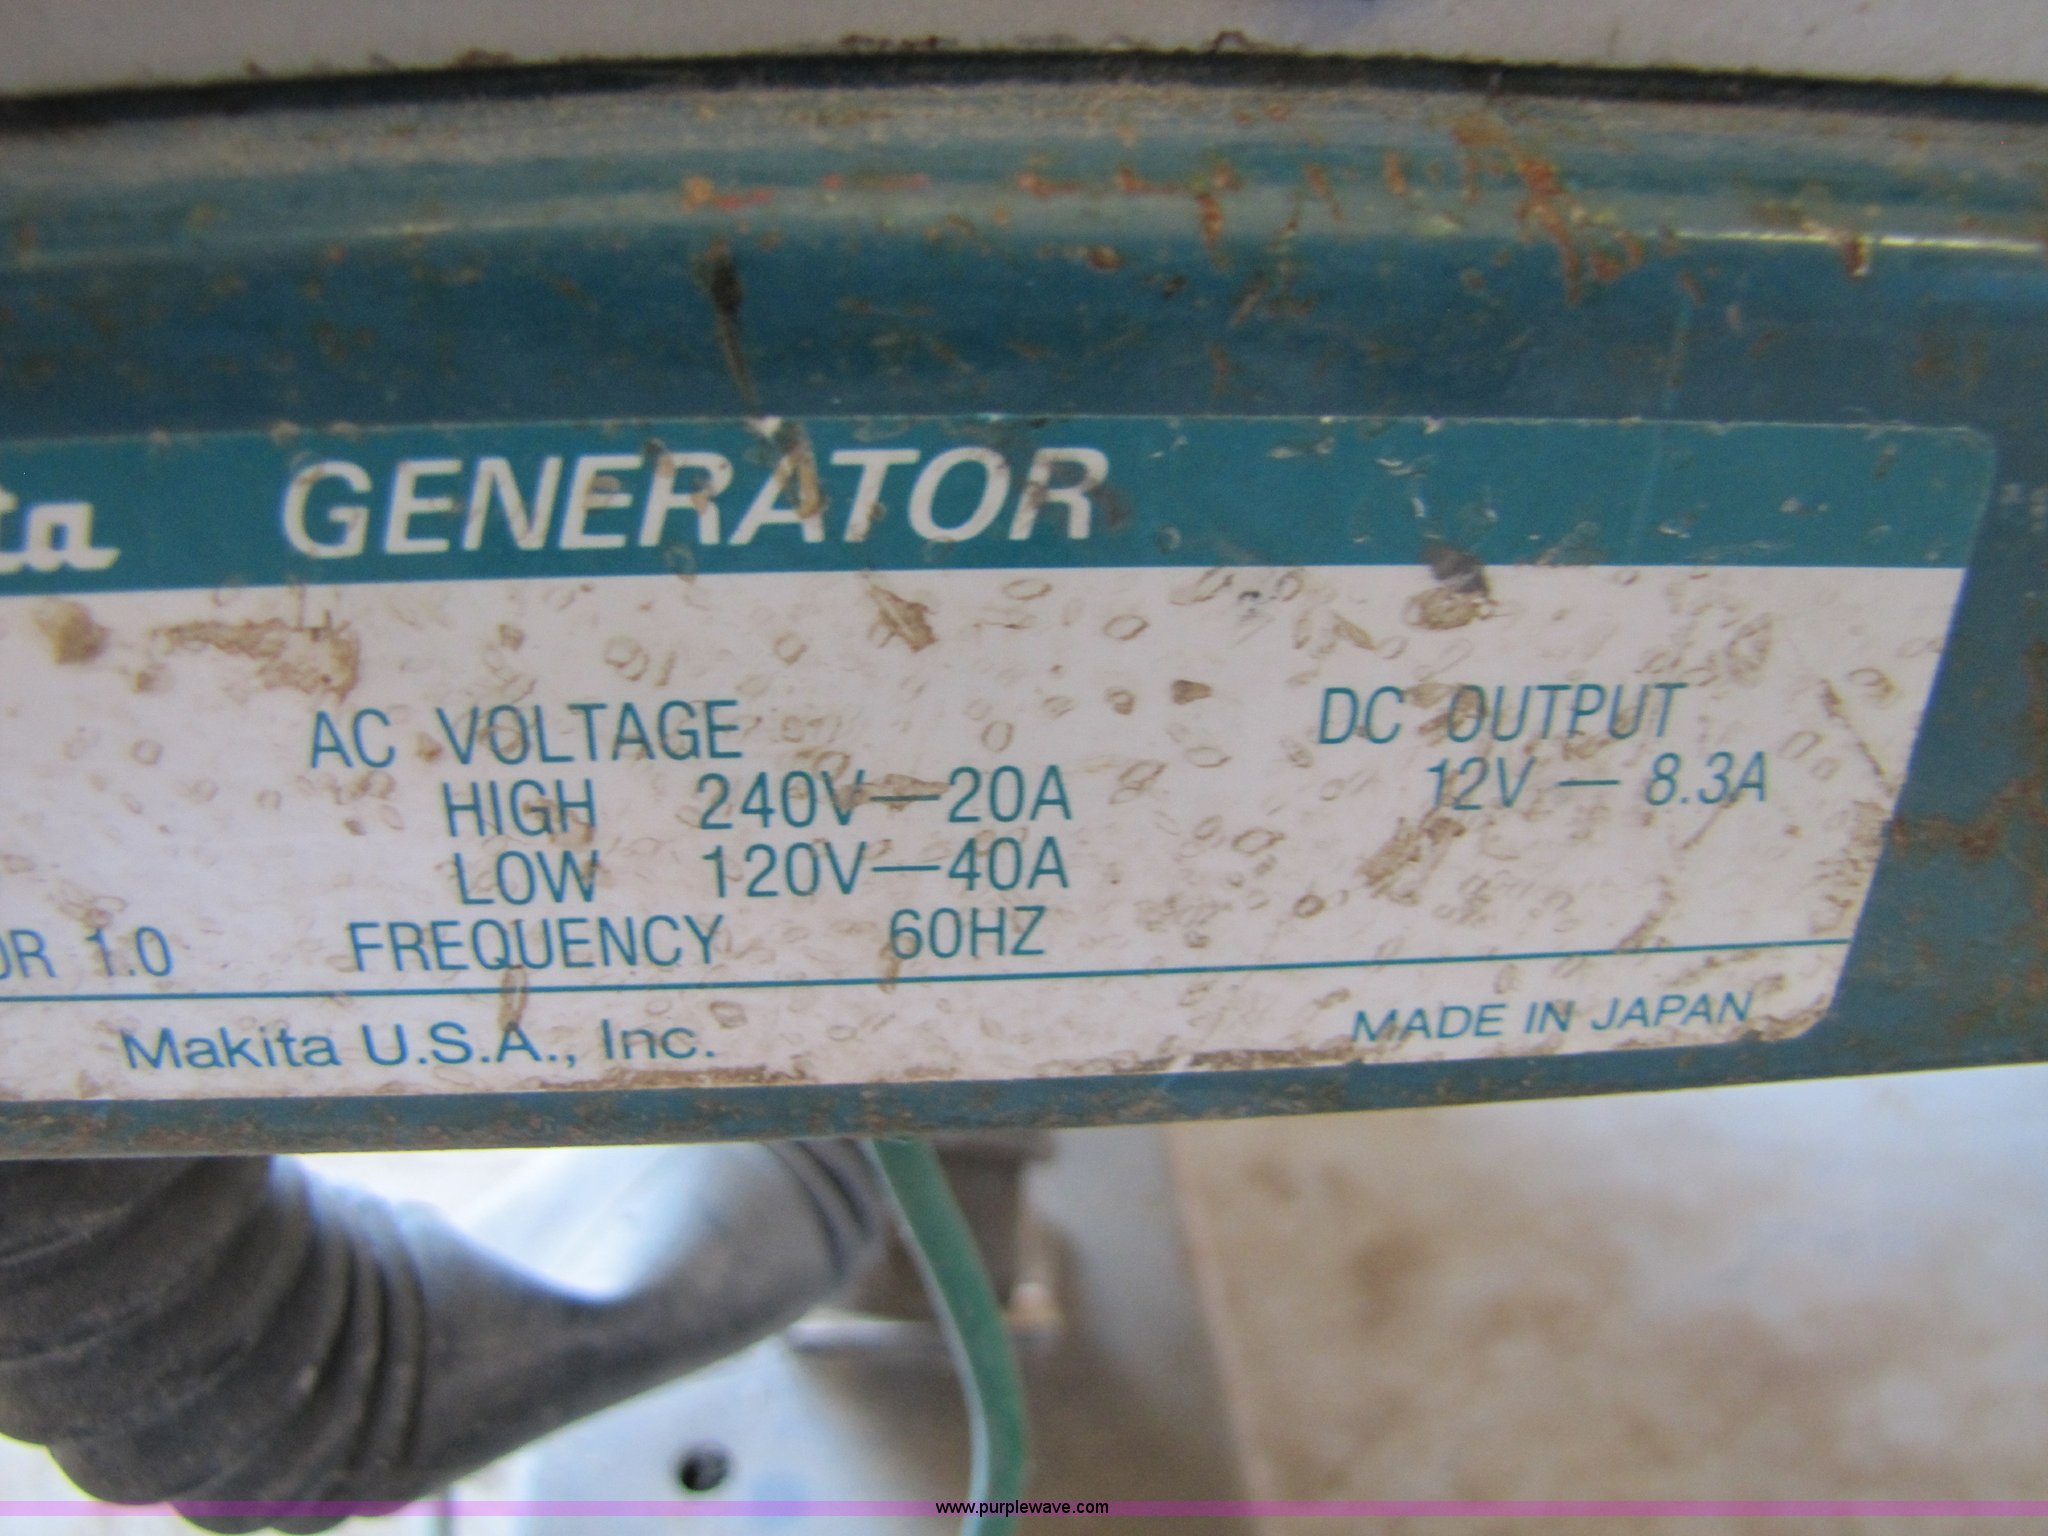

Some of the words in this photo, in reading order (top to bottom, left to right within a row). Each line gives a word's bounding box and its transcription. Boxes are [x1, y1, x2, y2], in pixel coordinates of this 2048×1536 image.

[281, 446, 1110, 560] GENERATOR
[309, 708, 397, 769] AC
[435, 700, 743, 765] VOLTAGE
[1318, 686, 1406, 745] DC
[1447, 682, 1689, 743] OUTPUT
[443, 778, 597, 837] HIGH
[1427, 757, 1538, 811] 12V
[1644, 751, 1768, 806] 8.3A
[453, 850, 598, 905] LOW
[85, 926, 174, 977] 1.0
[347, 913, 725, 972] FREQUENCY
[889, 905, 1047, 960] 60HZ
[120, 1026, 341, 1070] Makita
[361, 1020, 577, 1070] U.S.A.,
[603, 1019, 716, 1061] Inc.
[1352, 1003, 1507, 1043] MADE
[1525, 998, 1573, 1034] IN
[1591, 992, 1754, 1031] JAPAN
